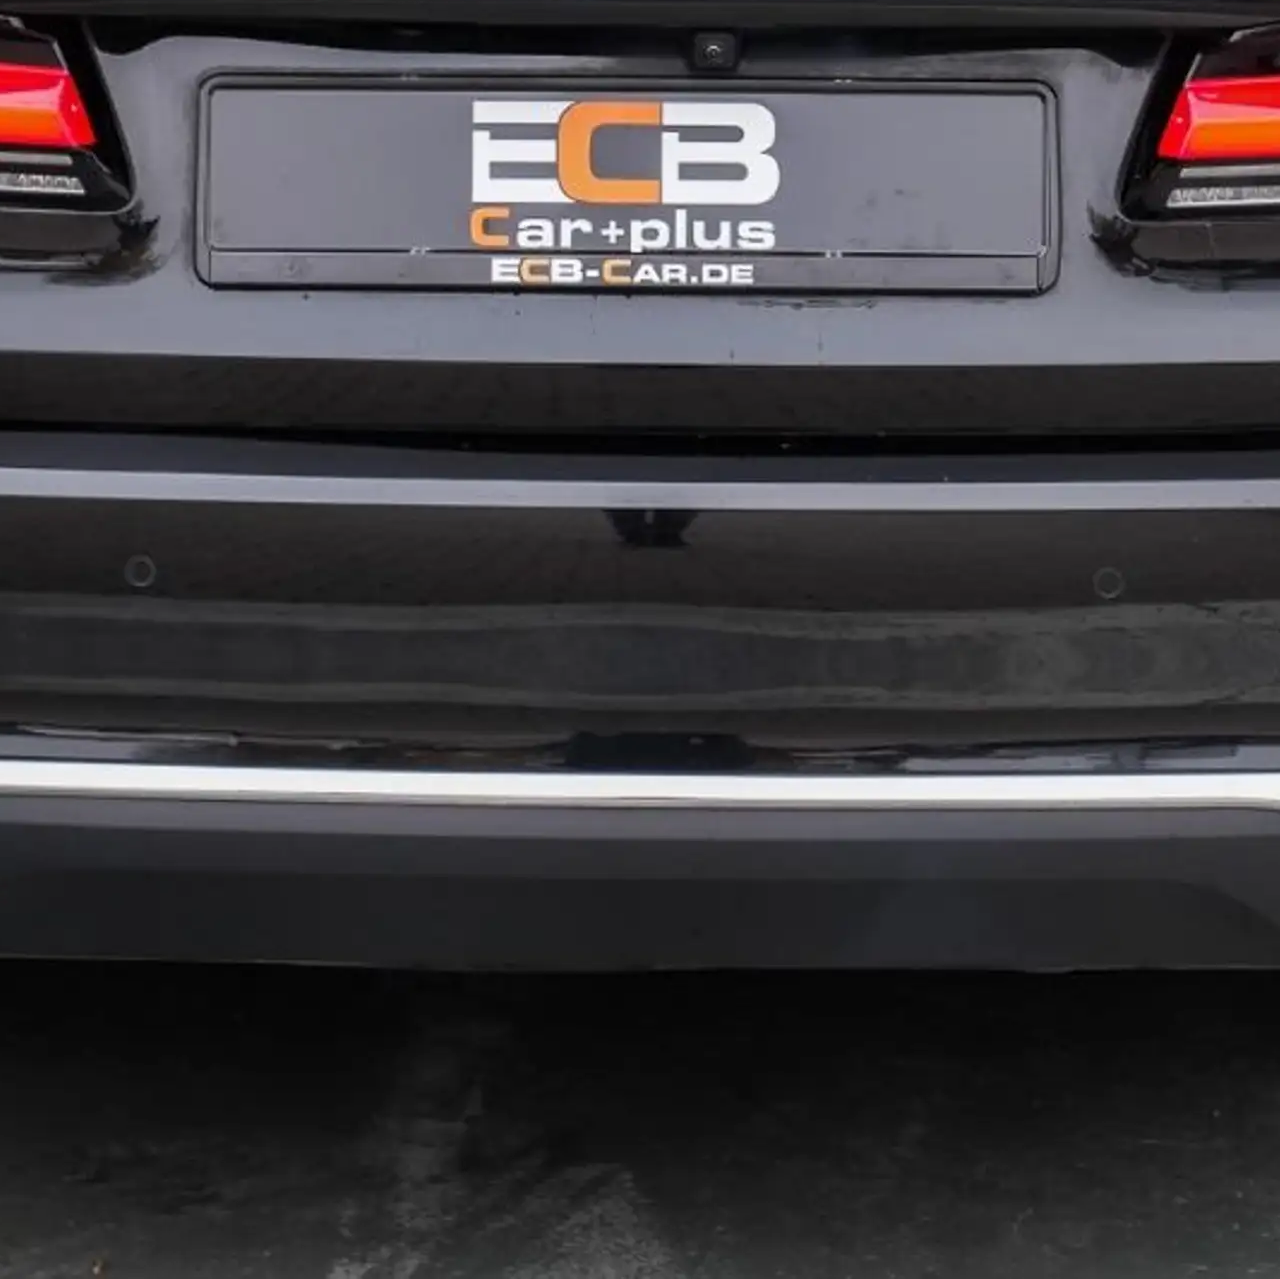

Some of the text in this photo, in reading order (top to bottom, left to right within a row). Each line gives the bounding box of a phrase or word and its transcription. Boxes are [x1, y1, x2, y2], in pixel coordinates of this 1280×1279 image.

[472, 100, 780, 205] ECB
[470, 206, 776, 252] Car+plus
[491, 258, 754, 284] ECB-CAR.DE
